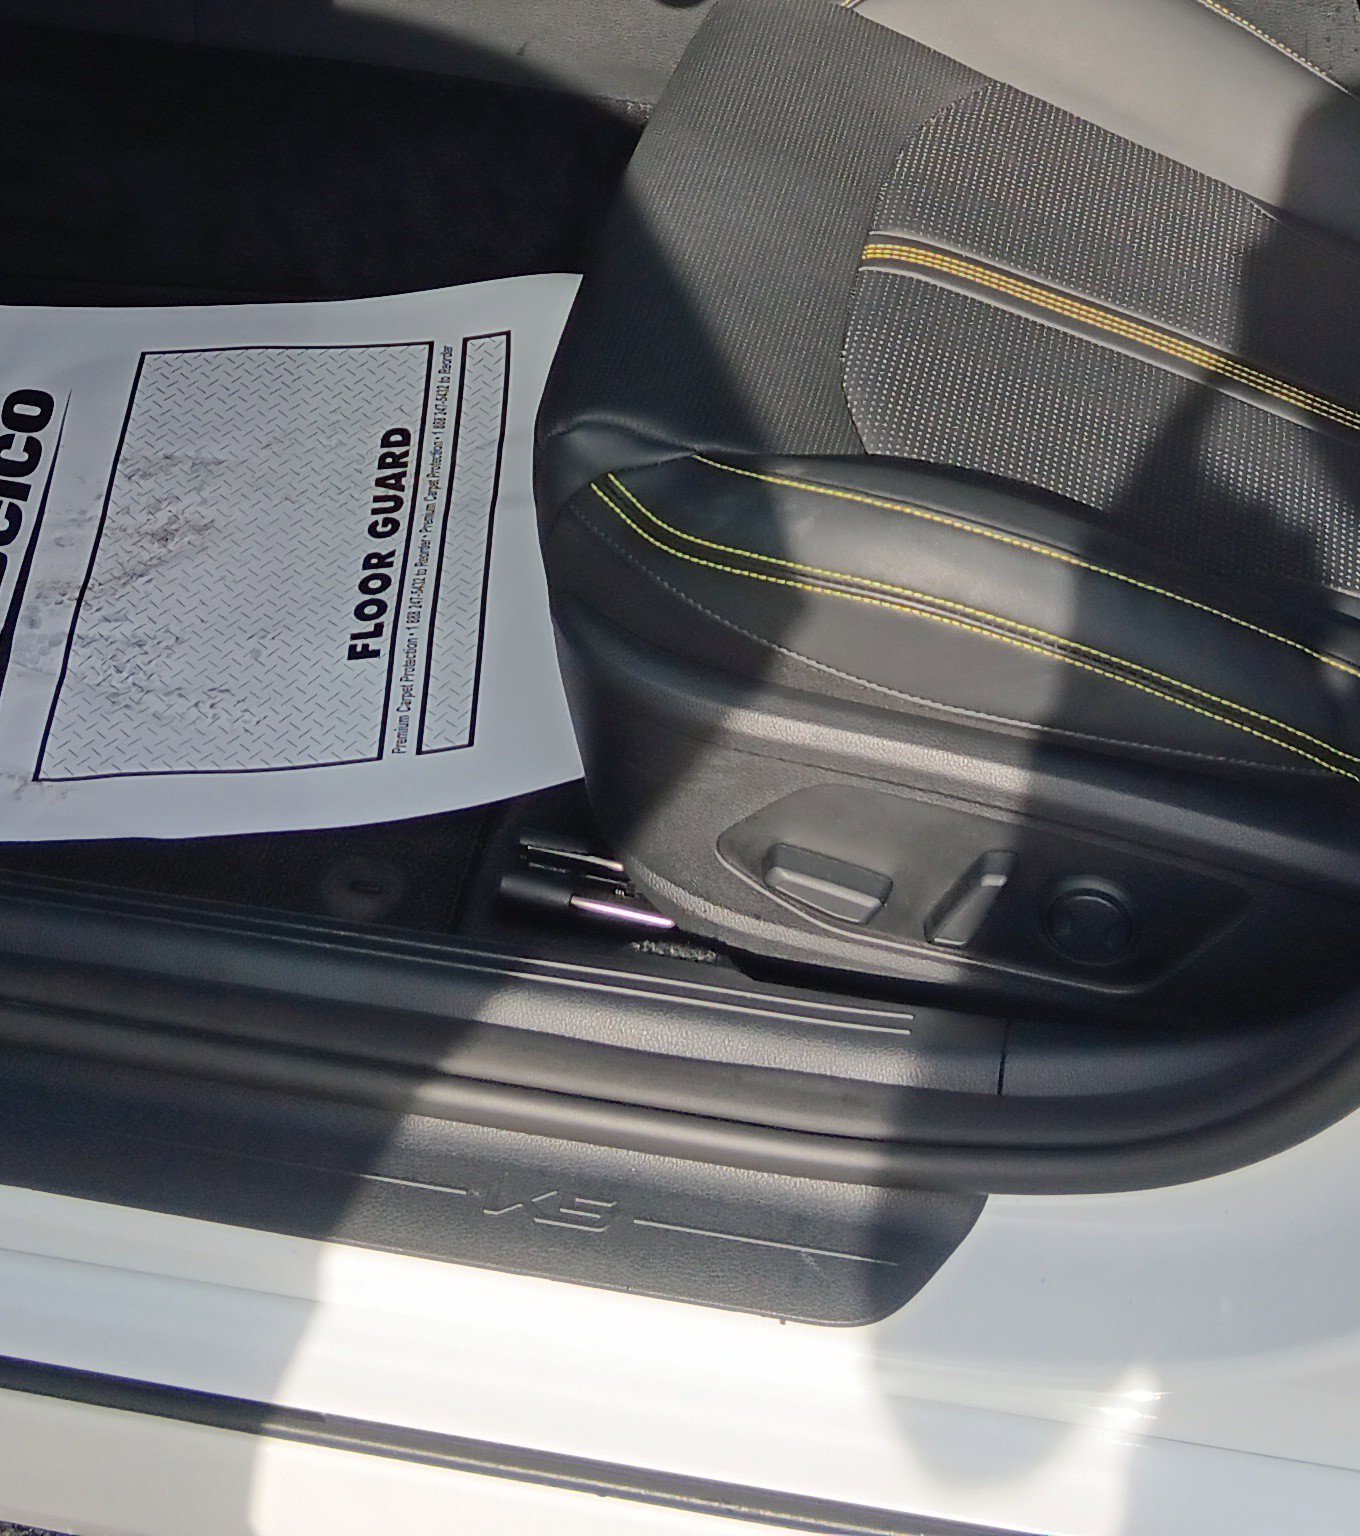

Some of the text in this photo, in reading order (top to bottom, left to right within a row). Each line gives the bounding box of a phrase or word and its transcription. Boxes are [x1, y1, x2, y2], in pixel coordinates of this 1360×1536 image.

[427, 440, 443, 478] Protection
[424, 480, 441, 501] Carpet
[419, 503, 436, 533] Premium
[347, 427, 412, 661] FLOOR GUARD
[415, 538, 432, 568] Reorder
[400, 638, 418, 682] Protection
[396, 685, 416, 712] Carpet
[392, 714, 410, 754] Premium
